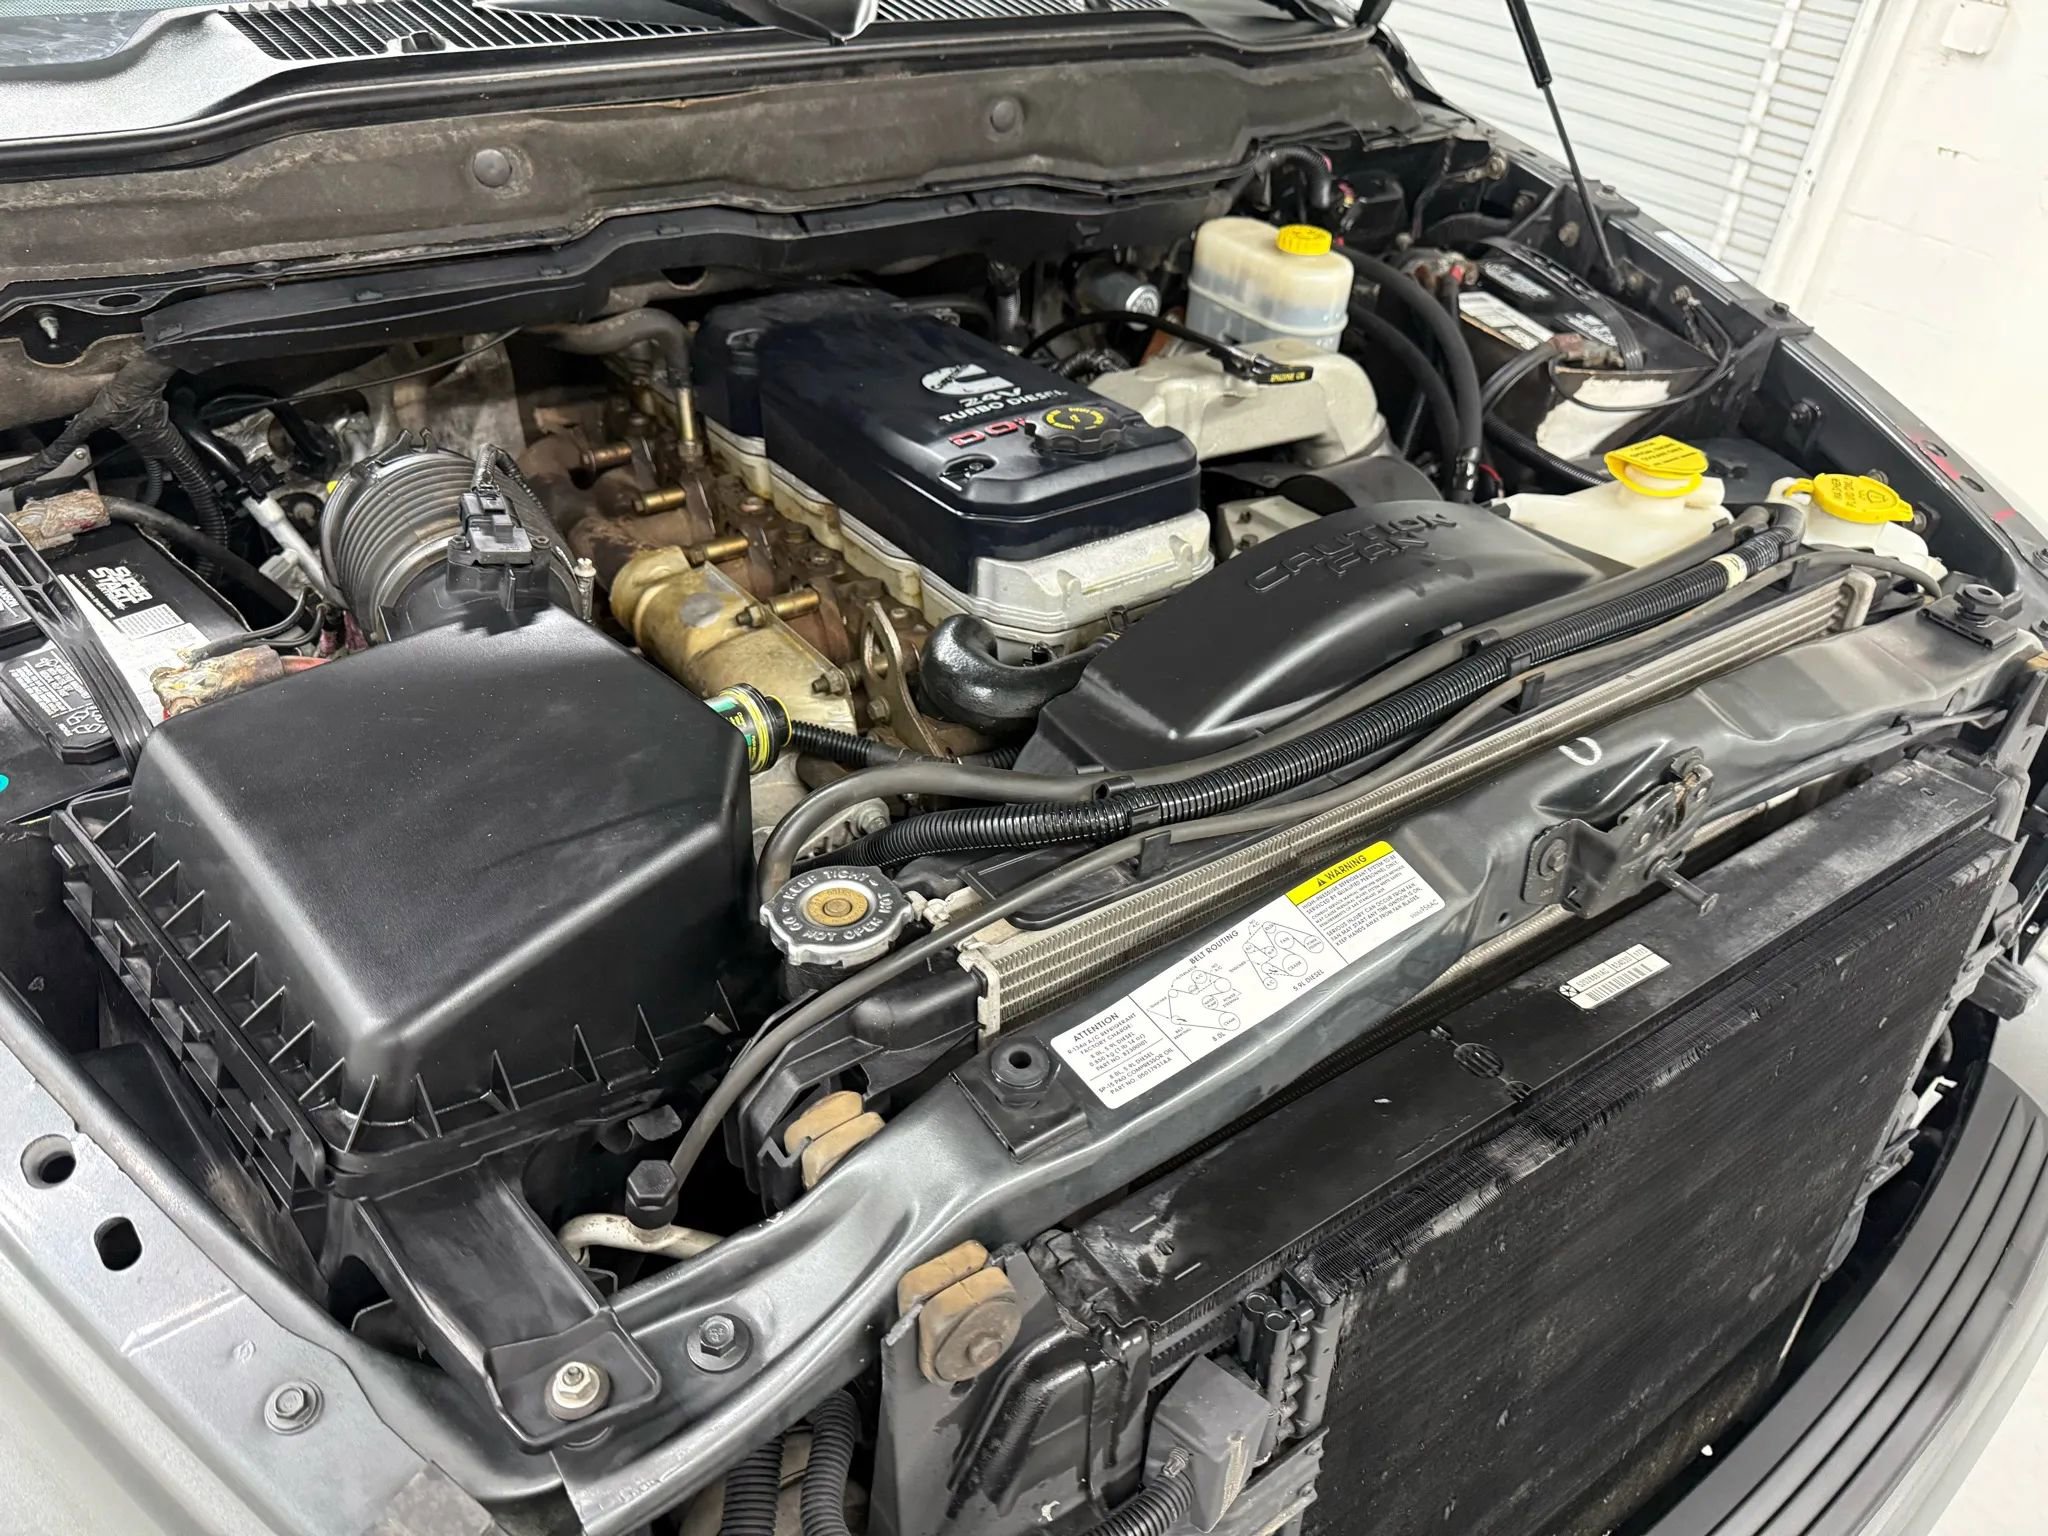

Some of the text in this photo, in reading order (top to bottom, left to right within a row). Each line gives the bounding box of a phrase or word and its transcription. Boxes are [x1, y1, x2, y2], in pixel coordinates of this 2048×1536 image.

[939, 389, 1062, 423] TURBO DIESEL
[958, 386, 1022, 409] 24V
[1248, 513, 1457, 591] CAUTION
[1326, 531, 1429, 574] FAN
[88, 567, 142, 604] START
[110, 566, 153, 600] SUPER
[1324, 854, 1367, 880] WARNING
[782, 870, 870, 900] KEEP TIGHT
[1306, 898, 1330, 914] SERVICED
[1336, 880, 1360, 896] QUALIFIED
[1360, 865, 1386, 883] PERSONNEL
[782, 916, 803, 931] DO
[802, 930, 837, 941] NOT
[843, 917, 884, 940] OPEN
[877, 892, 894, 914] HOT
[1326, 921, 1348, 937] SERIOUS
[1346, 911, 1365, 924] INJURY
[1364, 905, 1376, 913] CAN
[1375, 895, 1393, 907] OCCUR
[1392, 888, 1406, 897] FROM
[1330, 933, 1342, 941] FAN
[1340, 926, 1352, 935] MAY
[1352, 916, 1368, 928] START
[1367, 911, 1378, 919] ANY
[1376, 905, 1388, 913] TIME
[1387, 894, 1409, 907] IGNITION
[1335, 936, 1348, 946] KEEP
[1347, 925, 1366, 938] HANDS
[1365, 917, 1380, 928] AWAY
[1378, 910, 1394, 919] FROM
[1392, 904, 1402, 912] FAN
[1189, 930, 1238, 964] BELT ROUTING
[1292, 968, 1324, 992] 5.9L DIESEL
[1067, 1012, 1136, 1054] R-134a A/C REFRIGERANT
[1073, 1012, 1119, 1042] ATTENTION
[1116, 1032, 1135, 1044] DIESEL
[1212, 1032, 1226, 1042] 8.0L
[1080, 1038, 1107, 1055] FACTORY
[1135, 1051, 1154, 1064] DIESEL
[1096, 1060, 1110, 1071] PART
[1098, 1082, 1115, 1093] SP-15
[1126, 1053, 1164, 1077] COMPRESSOR
[1163, 1047, 1174, 1056] OIL
[1110, 1083, 1126, 1094] PART
